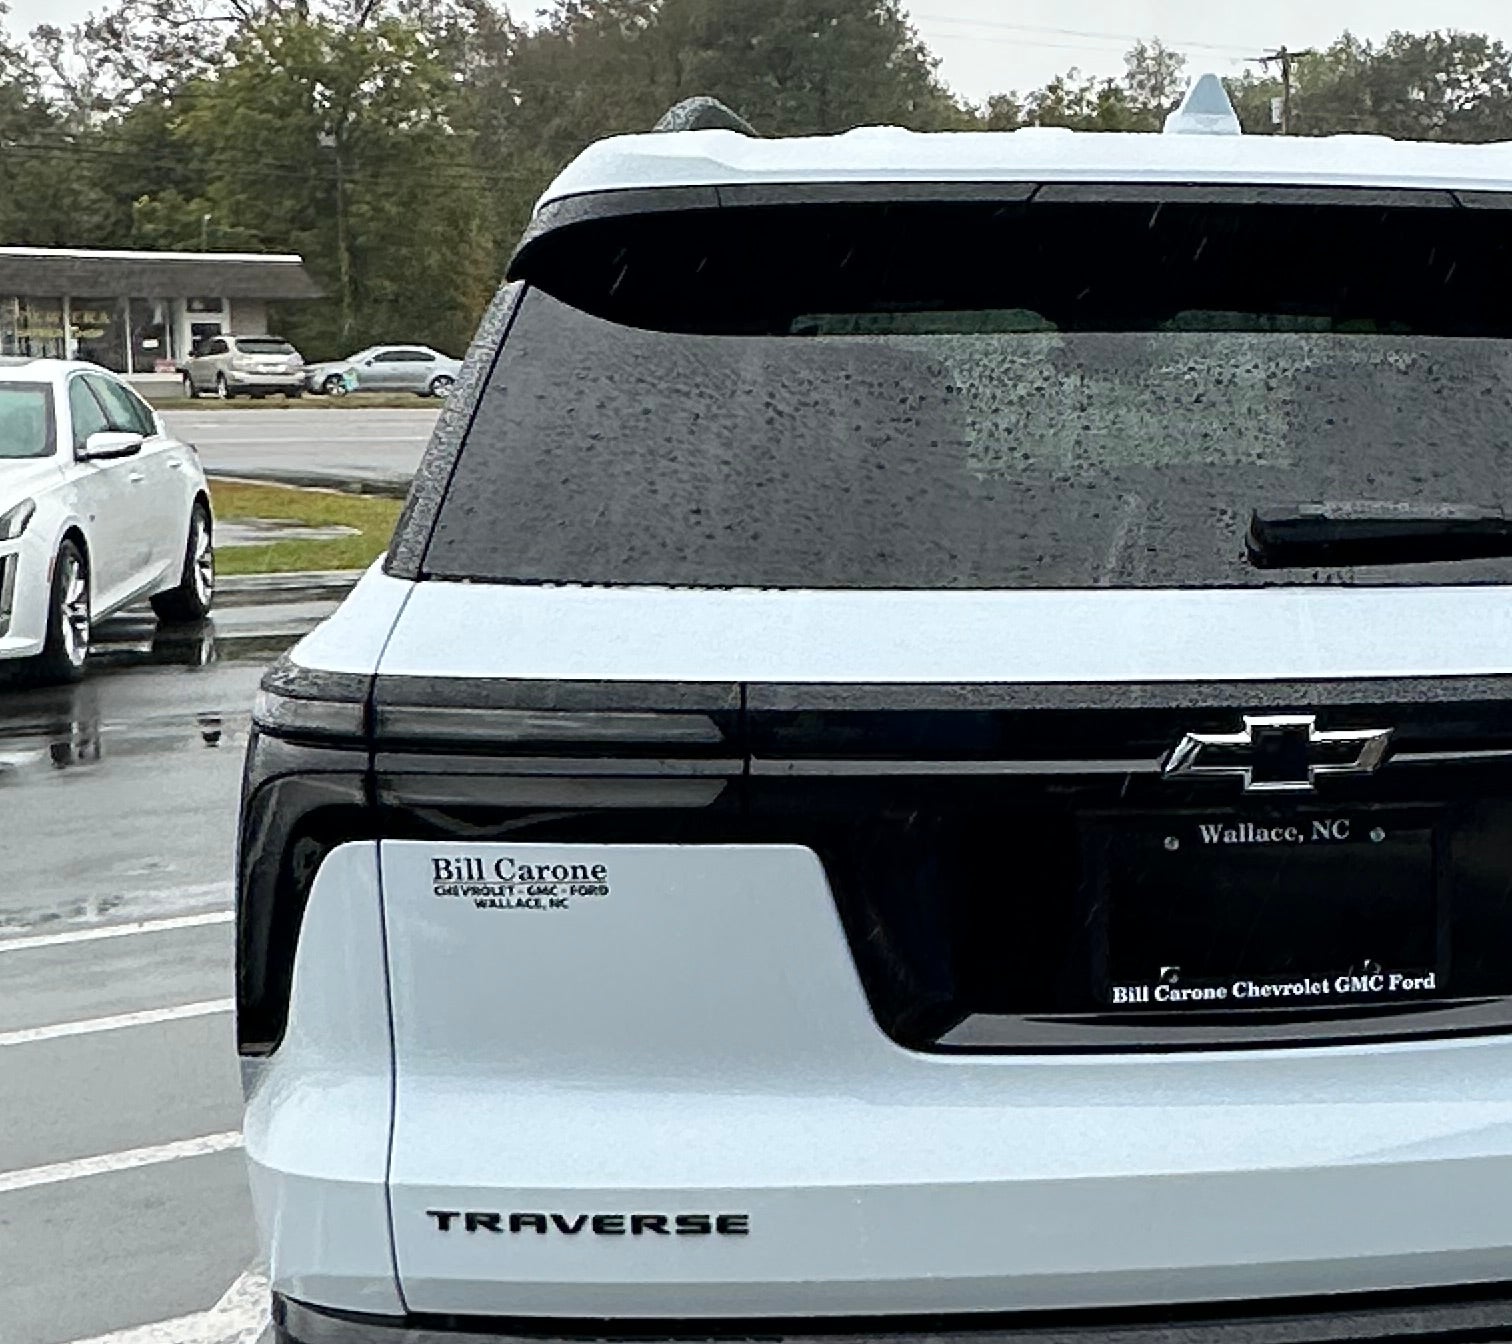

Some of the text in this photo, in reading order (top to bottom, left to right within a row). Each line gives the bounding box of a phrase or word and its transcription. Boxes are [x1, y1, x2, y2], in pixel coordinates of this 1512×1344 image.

[1199, 819, 1350, 844] Wallace, NC
[431, 857, 608, 882] Bill Carone
[434, 885, 610, 897] CHEVROLET GMC FORD
[474, 898, 569, 910] WALLACE, NC
[1112, 972, 1436, 1004] Bill Carone Chevrolet GMC Ford
[426, 1211, 750, 1236] TRAVERSE
